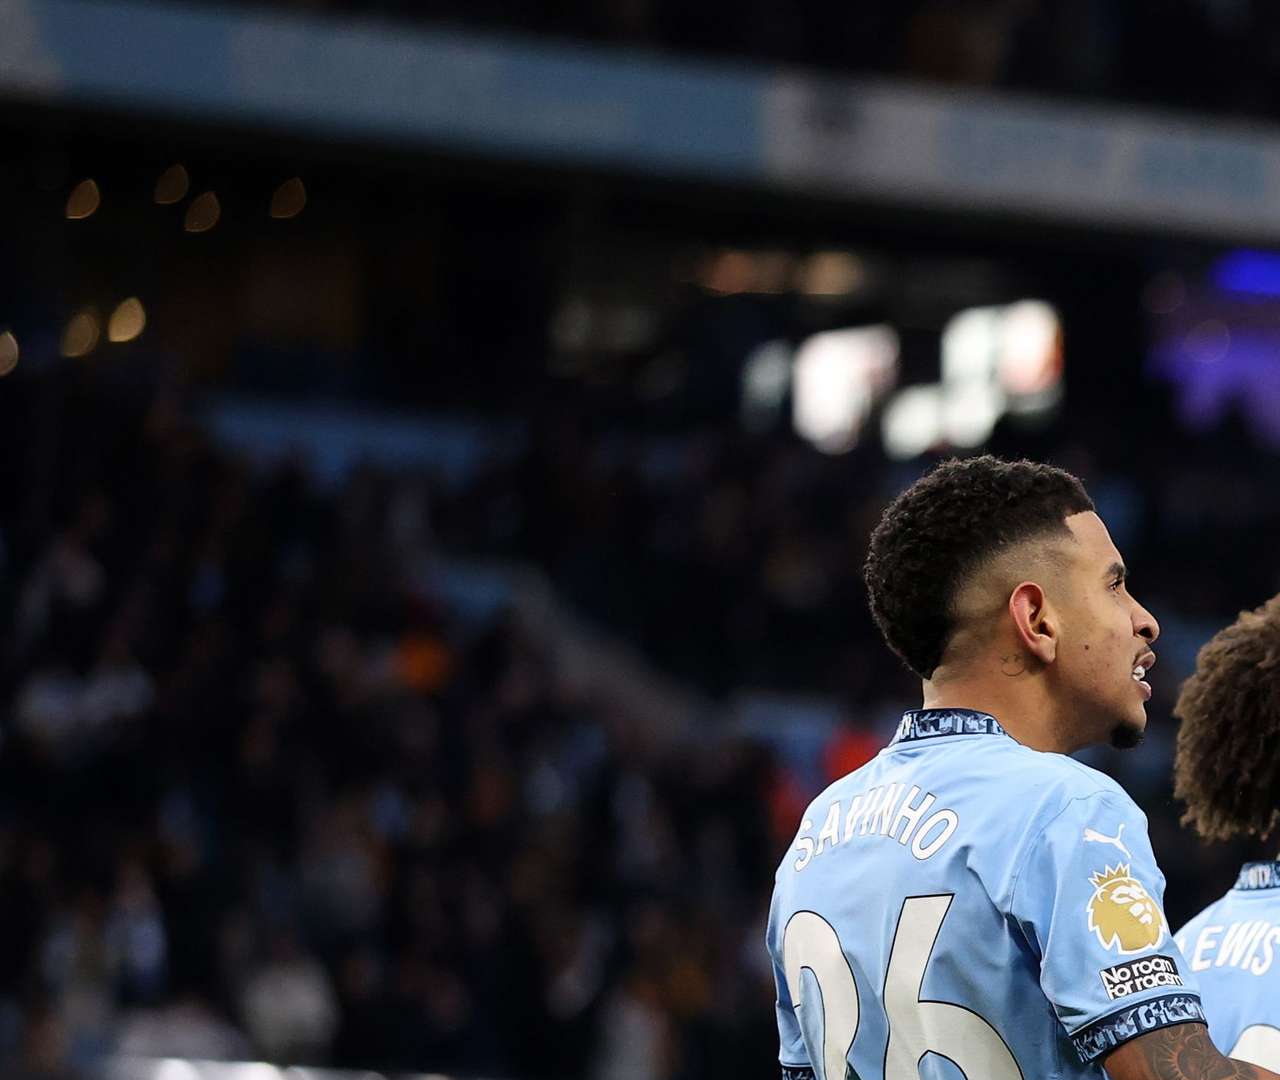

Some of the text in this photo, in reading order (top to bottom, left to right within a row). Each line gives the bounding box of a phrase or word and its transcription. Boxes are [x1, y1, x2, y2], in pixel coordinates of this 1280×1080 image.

[794, 782, 959, 873] SAVINHO
[1101, 958, 1174, 985] No room
[1135, 972, 1184, 990] racism
